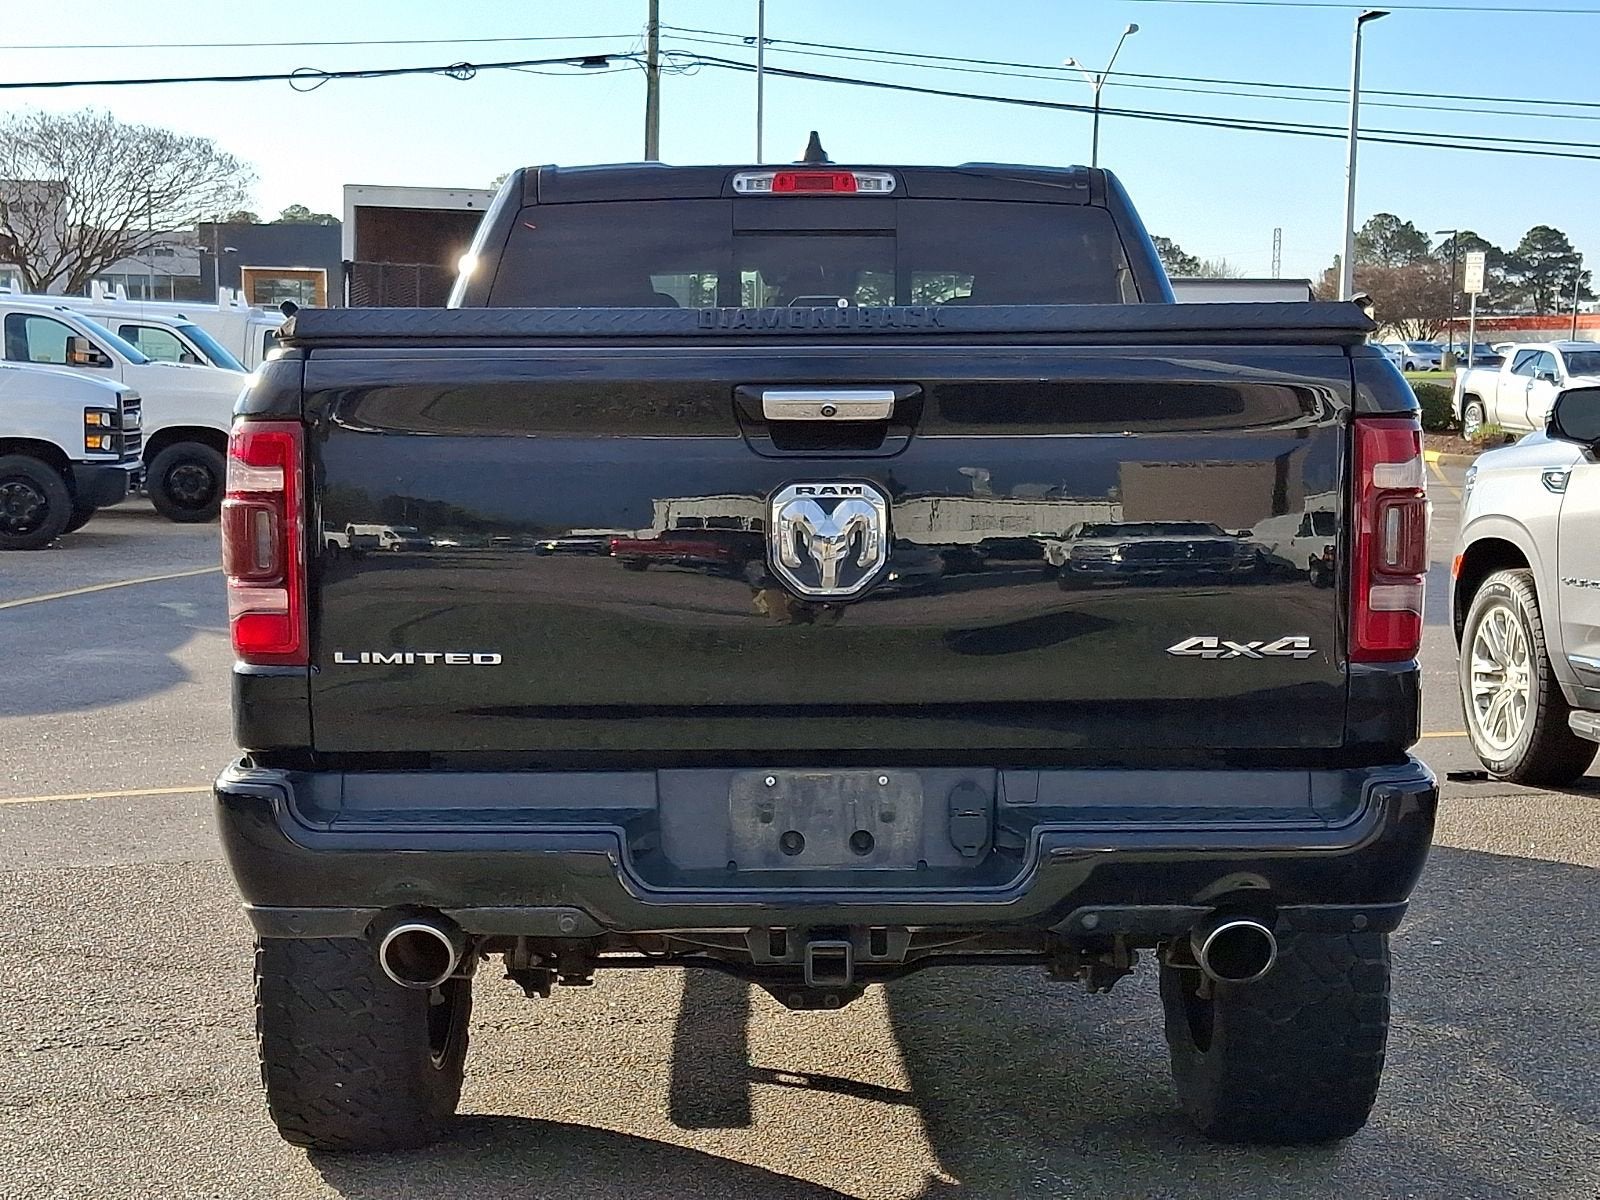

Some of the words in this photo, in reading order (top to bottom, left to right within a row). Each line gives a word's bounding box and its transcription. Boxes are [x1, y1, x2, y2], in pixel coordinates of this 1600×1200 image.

[795, 486, 862, 495] RAM
[1166, 636, 1317, 659] 4x4
[334, 652, 502, 665] LIMITED
